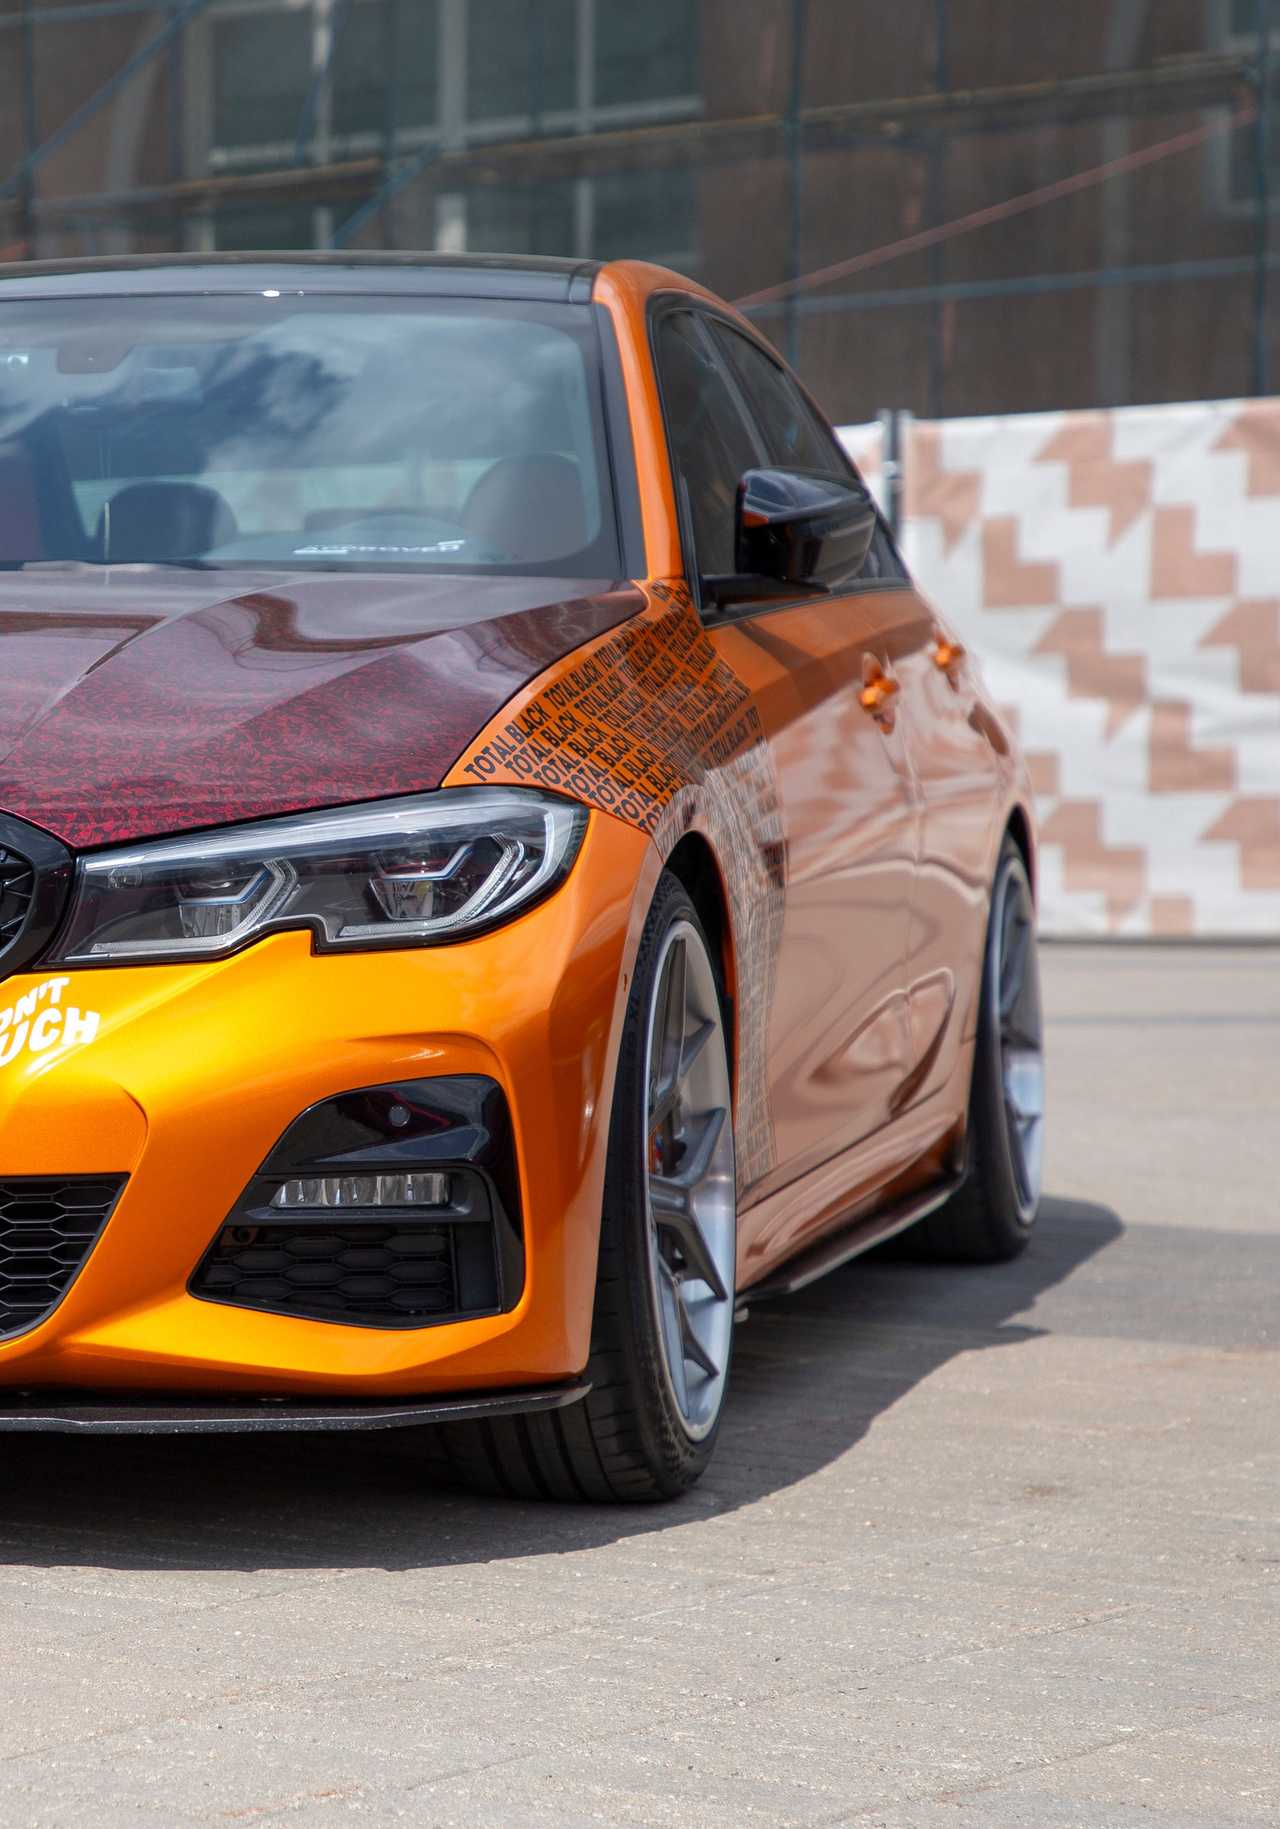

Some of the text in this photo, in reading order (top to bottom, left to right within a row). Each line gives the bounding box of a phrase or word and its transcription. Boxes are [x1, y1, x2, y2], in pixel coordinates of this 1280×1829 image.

[464, 735, 517, 782] TOTAL
[504, 701, 552, 745] BLACK
[543, 677, 580, 710] TOTAL
[569, 658, 604, 694] BLACK
[593, 642, 622, 671] TOTAL
[610, 627, 641, 656] BLACK
[504, 738, 553, 780] TOTAL
[540, 710, 584, 749] BLACK
[574, 689, 610, 720] TOTAL
[596, 671, 629, 704] BLACK
[618, 653, 646, 683] TOTAL
[634, 636, 660, 667] BLACK
[677, 698, 705, 723] TOTAL
[692, 680, 724, 709] BLACK
[533, 749, 581, 787] TOTAL
[567, 722, 610, 759] BLACK
[597, 701, 632, 732] TOTAL
[617, 686, 649, 717] BLACK
[637, 669, 665, 698] TOTAL
[651, 653, 679, 682] BLACK
[562, 759, 610, 799] TOTAL
[595, 732, 636, 768] BLACK
[622, 717, 655, 743] TOTAL
[640, 700, 669, 729] BLACK
[657, 684, 684, 712] TOTAL
[672, 667, 699, 697] BLACK
[660, 714, 690, 742] BLACK
[621, 744, 661, 780] BLACK
[646, 730, 675, 754] TOTAL
[587, 769, 635, 810] TOTAL
[613, 769, 659, 820] TOTAL
[645, 760, 682, 794] BLACK
